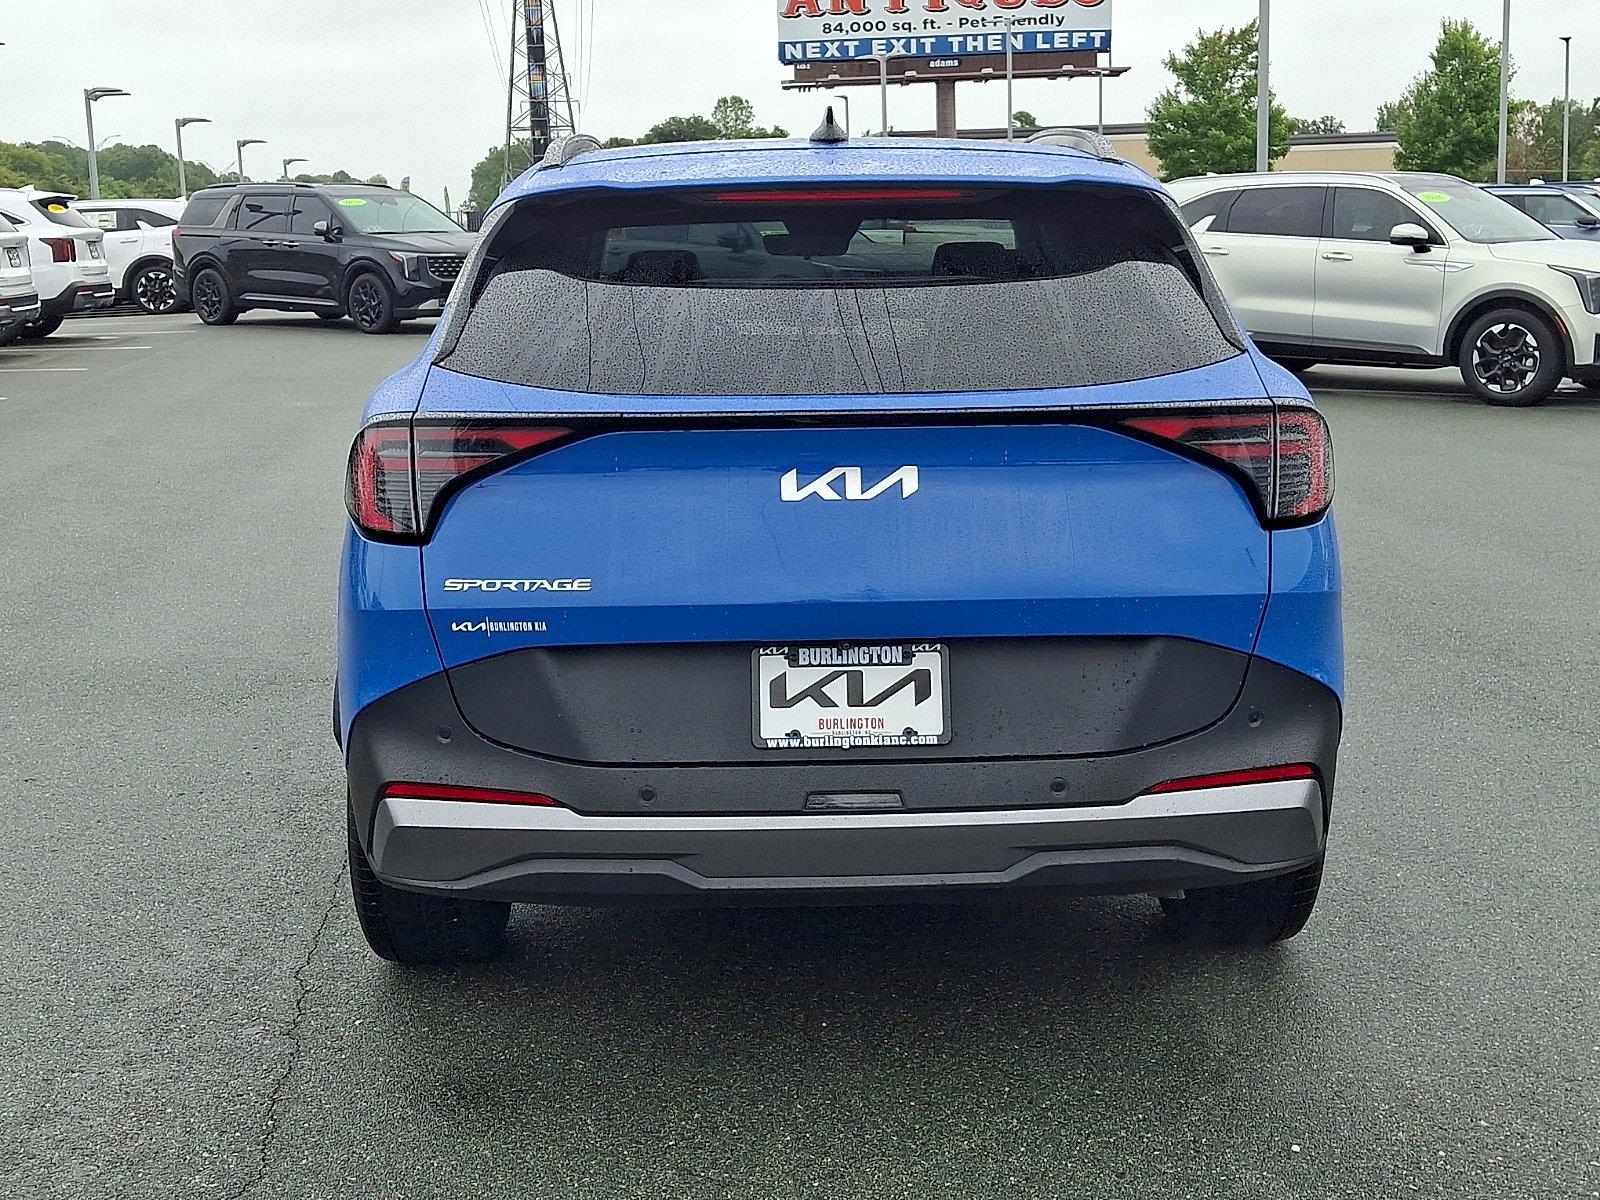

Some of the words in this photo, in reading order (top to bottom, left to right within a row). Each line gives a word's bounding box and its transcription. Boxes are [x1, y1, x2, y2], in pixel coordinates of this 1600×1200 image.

[822, 20, 886, 35] 84,000
[892, 20, 917, 32] sq.
[922, 18, 941, 30] ft.
[959, 16, 987, 28] Pet
[784, 41, 859, 60] NEXT
[872, 38, 936, 55] EXIT
[948, 33, 1023, 53] THEN
[1036, 31, 1106, 49] LEFT
[929, 59, 959, 68] adams
[780, 465, 919, 501] KIA
[443, 578, 592, 592] SPORTAGE
[799, 646, 903, 665] BURLINGTON
[770, 669, 932, 708] KIA
[818, 717, 885, 730] BURLINGTON
[767, 735, 938, 749] www.burlingtonkianc.com
